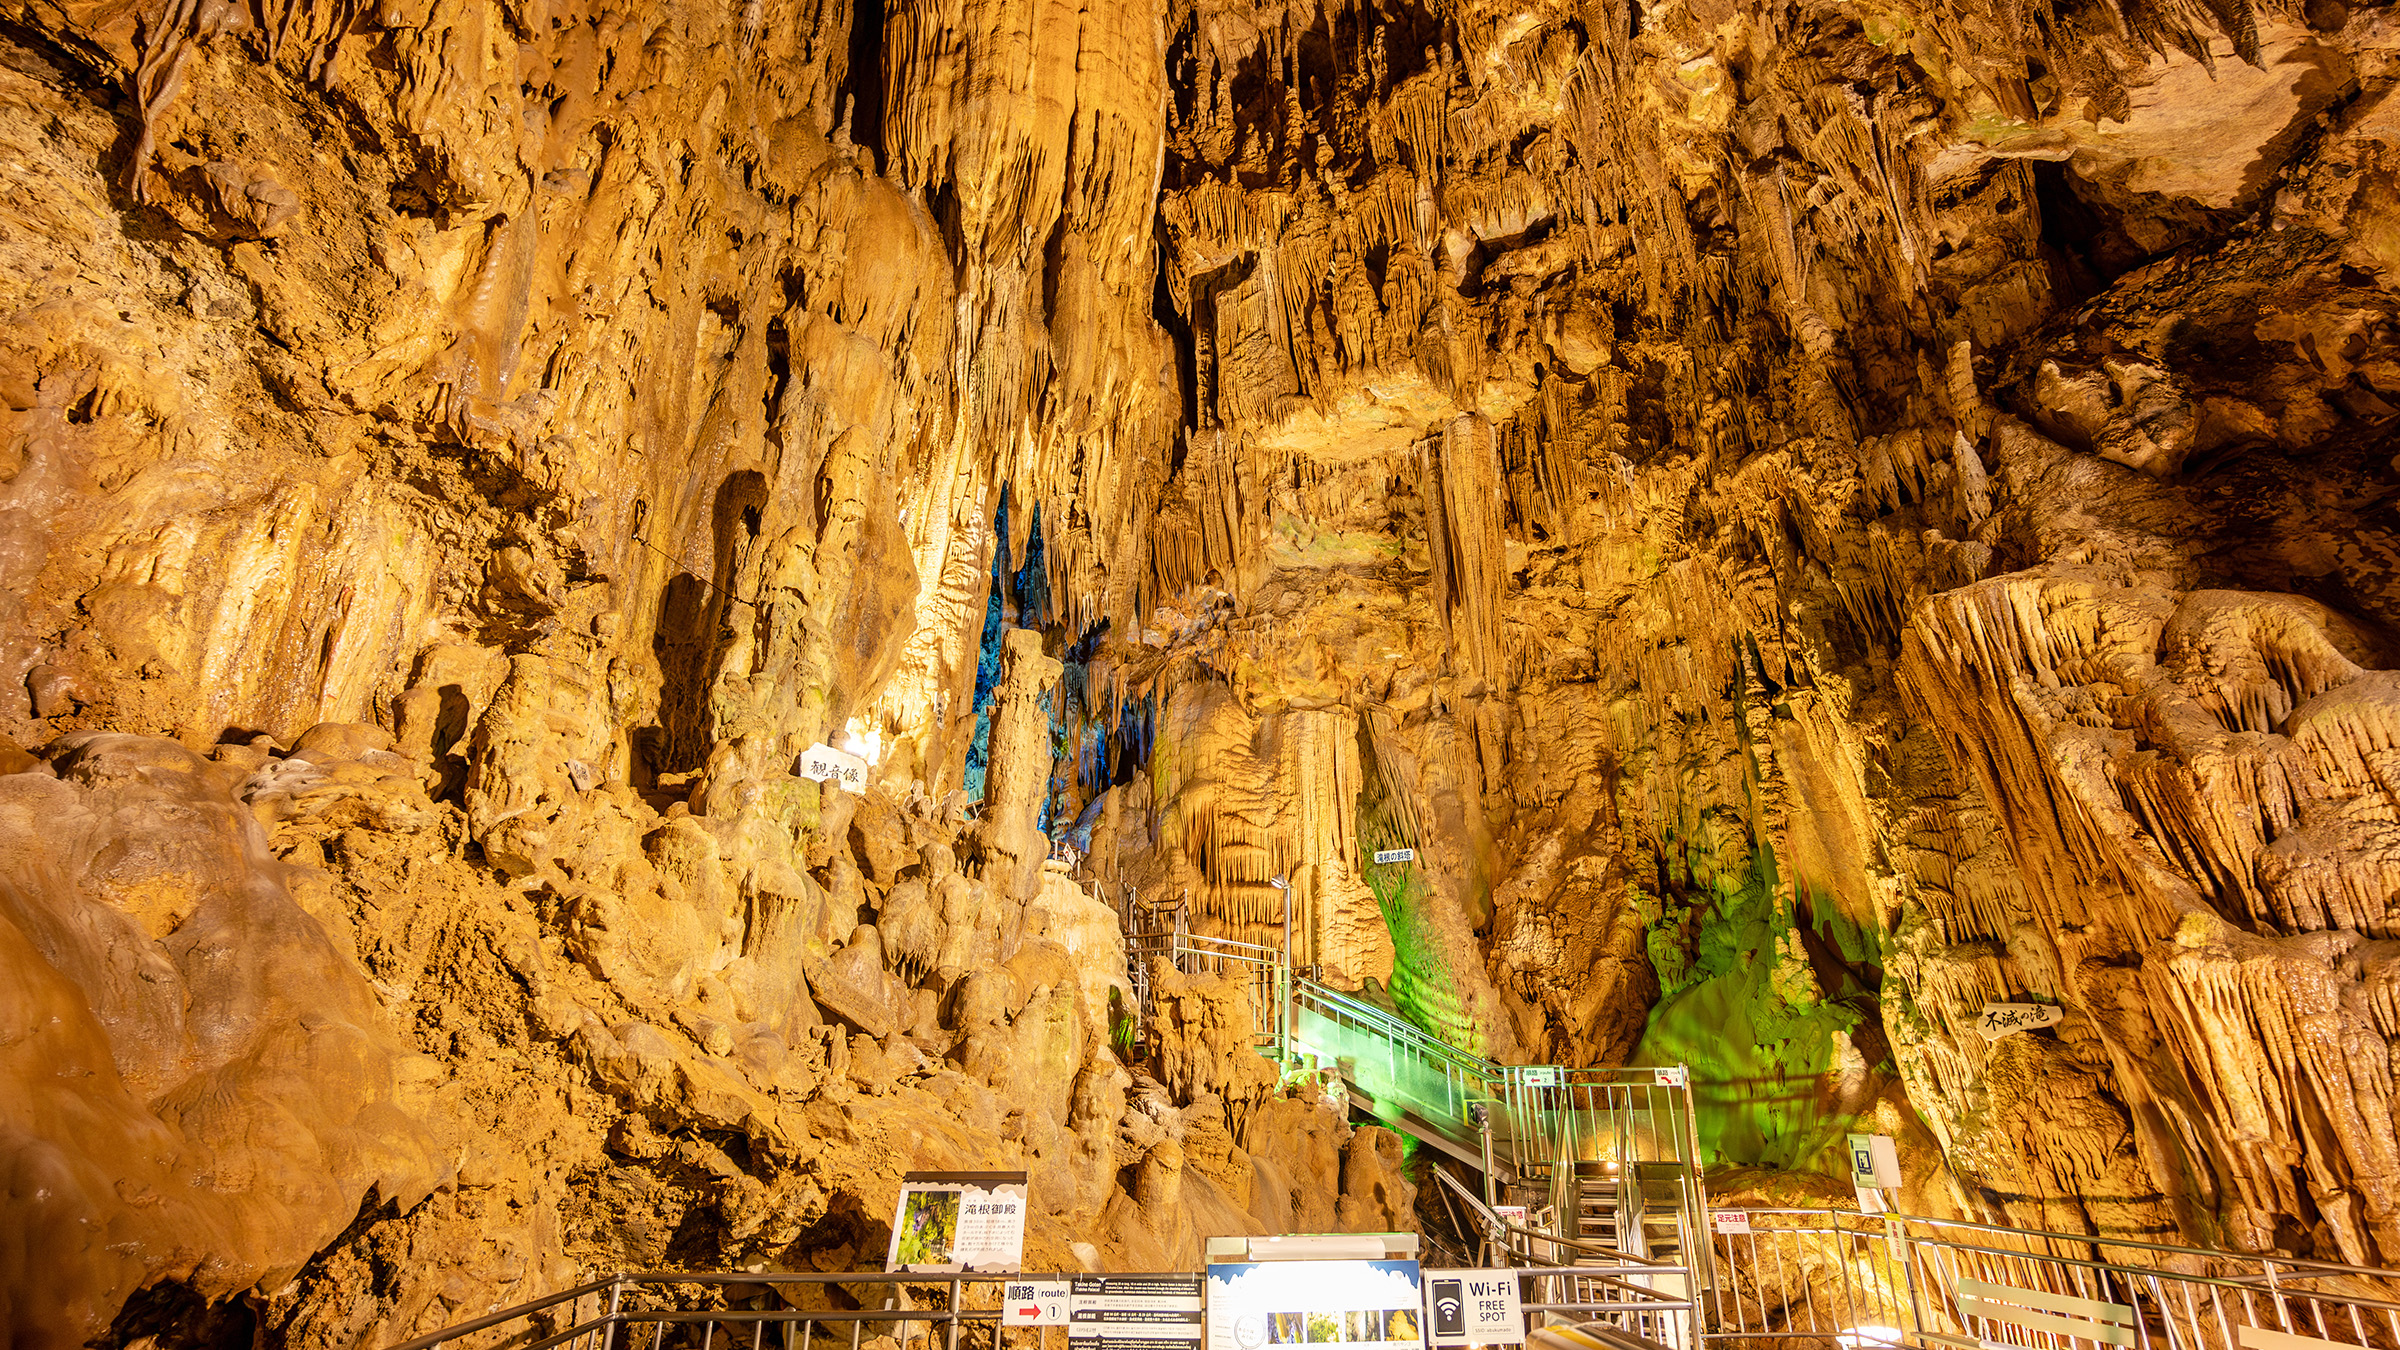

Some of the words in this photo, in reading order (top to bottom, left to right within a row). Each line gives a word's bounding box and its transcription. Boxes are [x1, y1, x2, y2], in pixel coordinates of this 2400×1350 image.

[810, 760, 859, 783] 観音像
[1376, 850, 1411, 862] 滝根の斜塔
[1985, 1005, 2050, 1032] 不滅の滝
[964, 1203, 1017, 1215] 滝根御殿
[1717, 1214, 1747, 1222] 足元注意
[1008, 1285, 1035, 1300] 順路
[1037, 1288, 1069, 1299] (route)
[1469, 1281, 1511, 1296] Wi-Fi
[1479, 1300, 1505, 1311] FREE
[1480, 1312, 1506, 1322] SPOT
